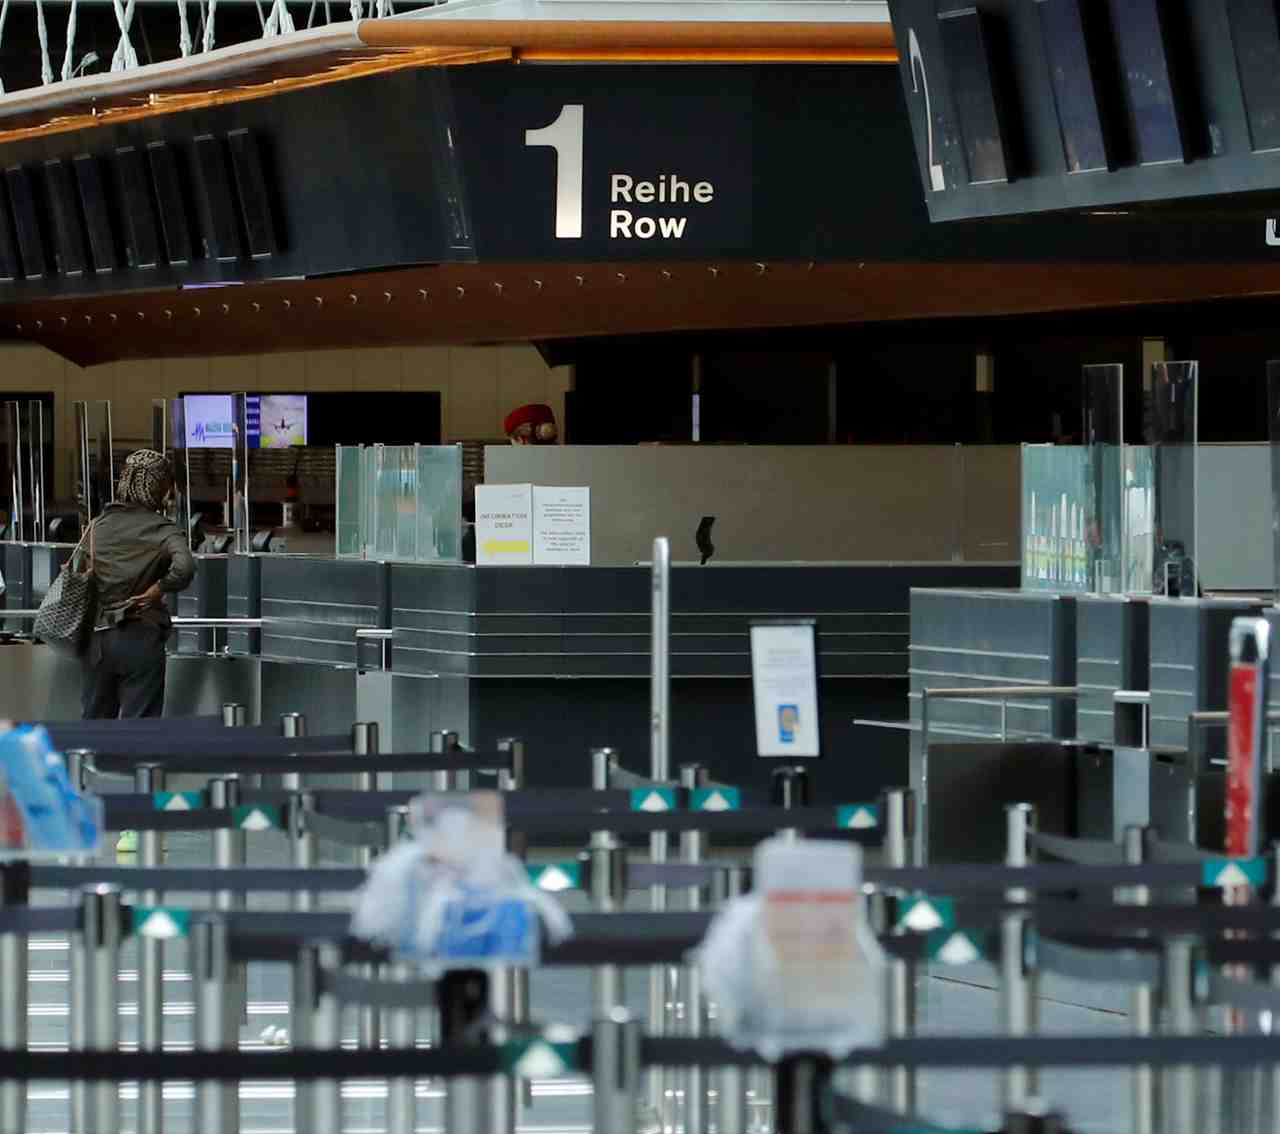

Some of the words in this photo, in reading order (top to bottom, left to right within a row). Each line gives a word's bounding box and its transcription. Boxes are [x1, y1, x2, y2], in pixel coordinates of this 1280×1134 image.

[525, 104, 584, 238] 1
[611, 174, 714, 203] Reihe
[610, 209, 687, 238] Row
